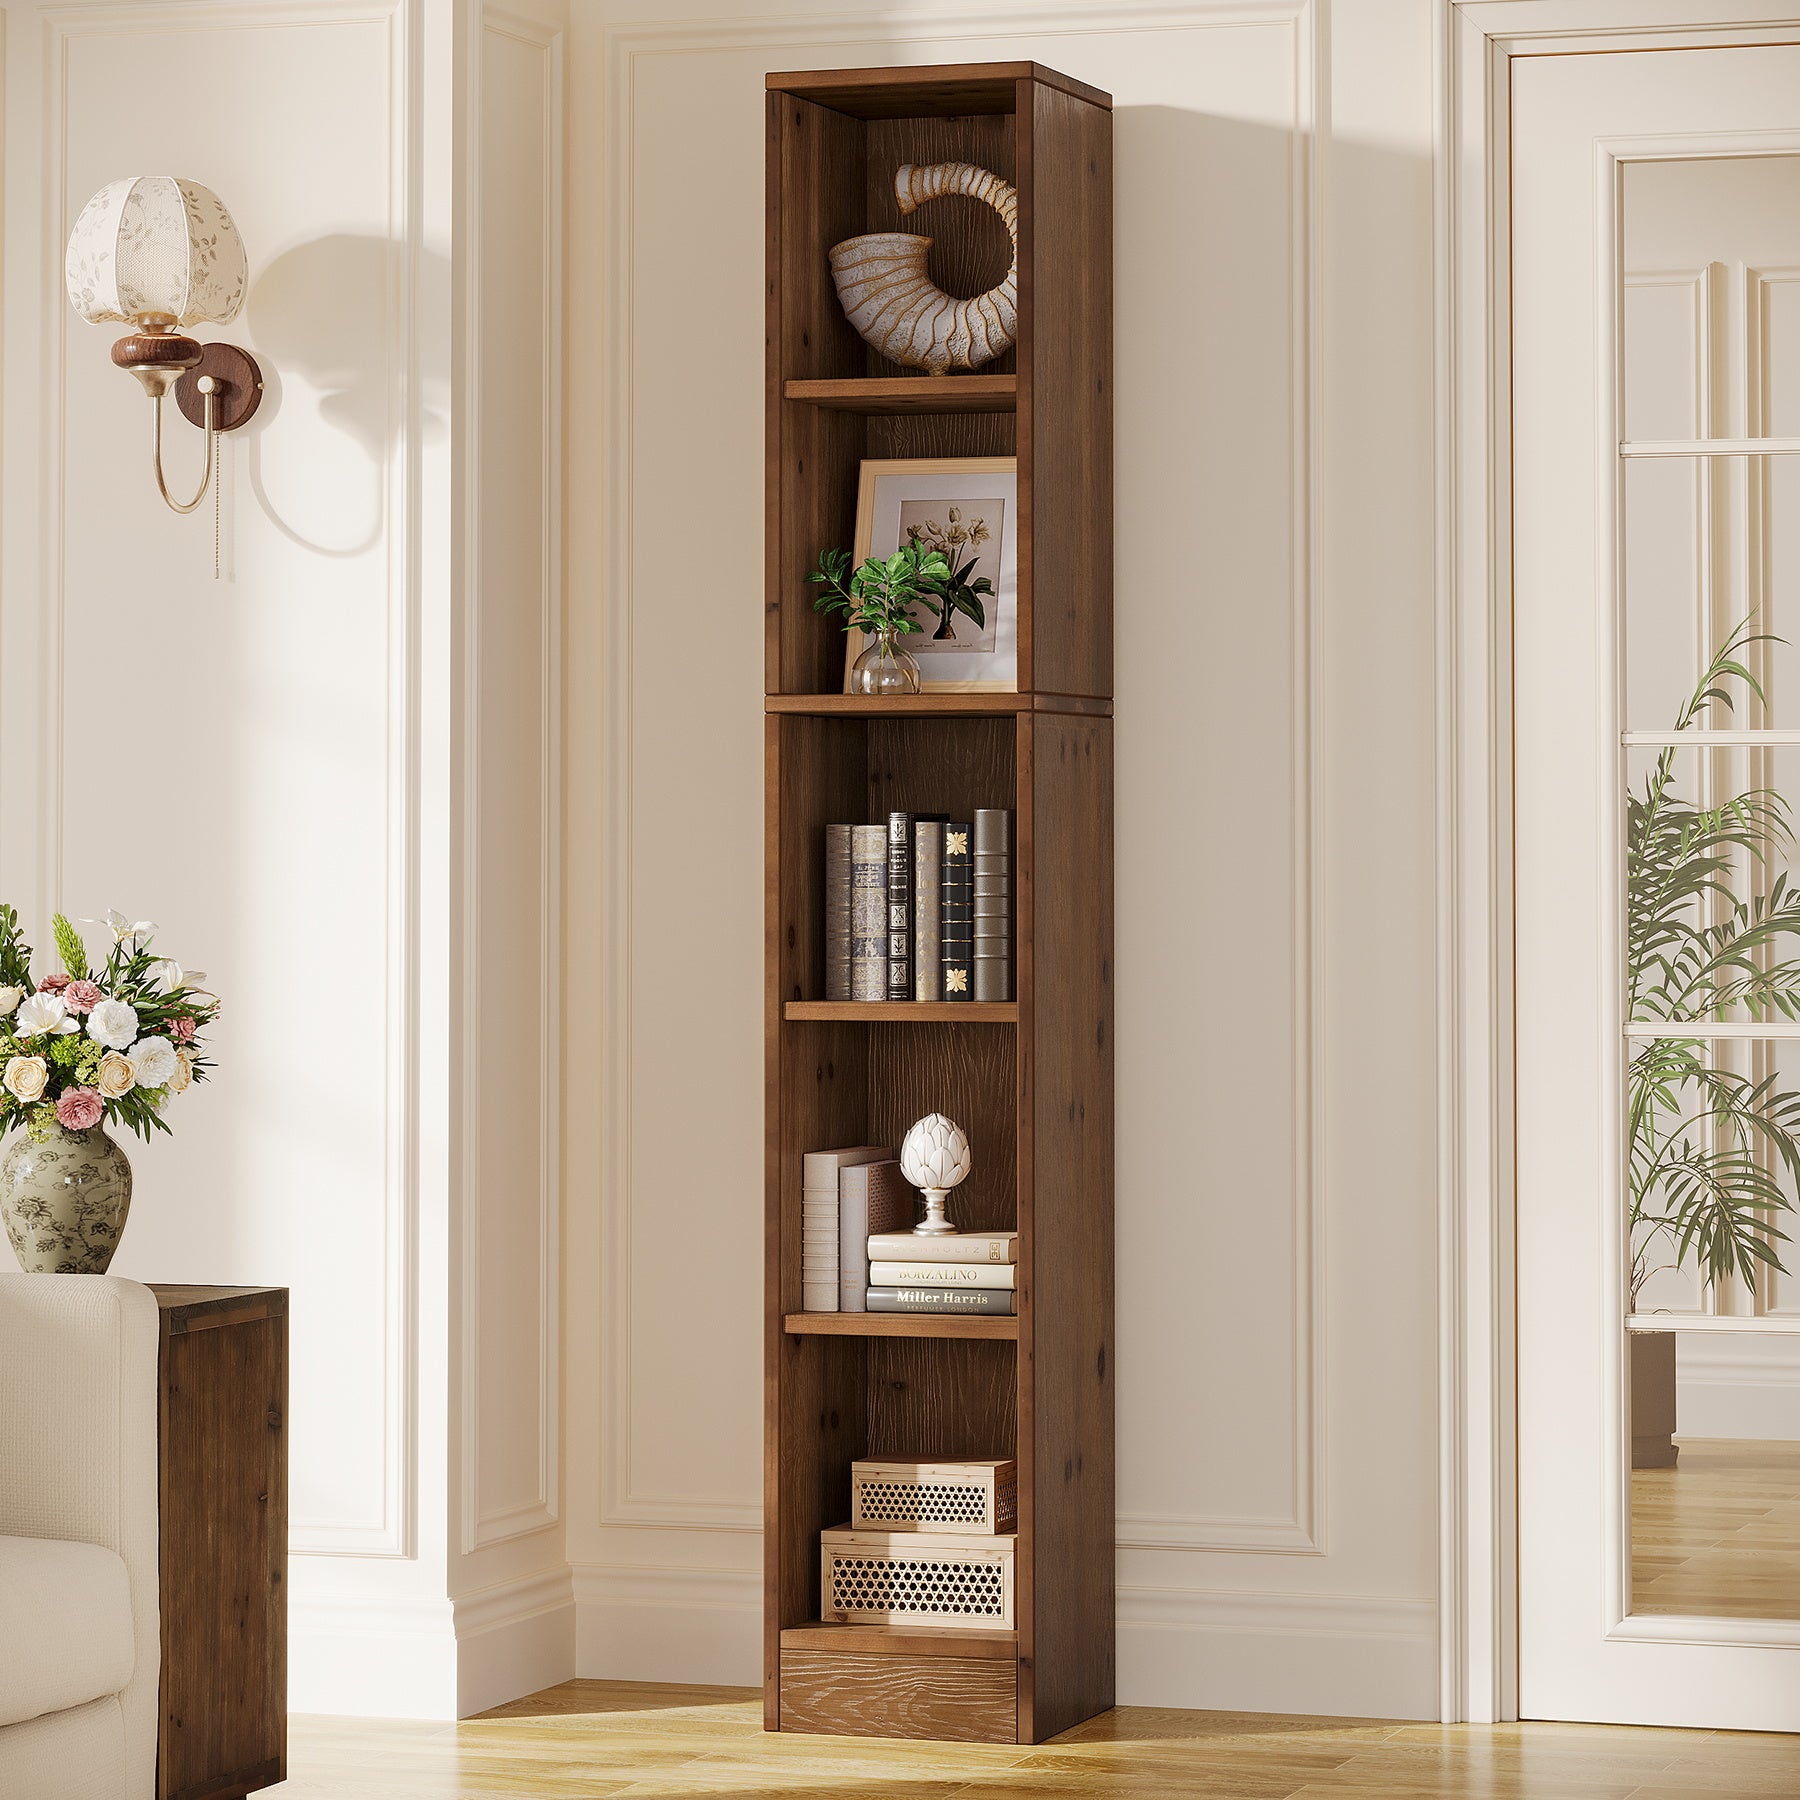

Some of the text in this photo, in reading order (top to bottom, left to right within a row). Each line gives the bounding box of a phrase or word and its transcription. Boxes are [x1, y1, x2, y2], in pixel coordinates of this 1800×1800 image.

[899, 1269, 978, 1281] BORZALINO
[897, 1290, 988, 1305] Miller Harris
